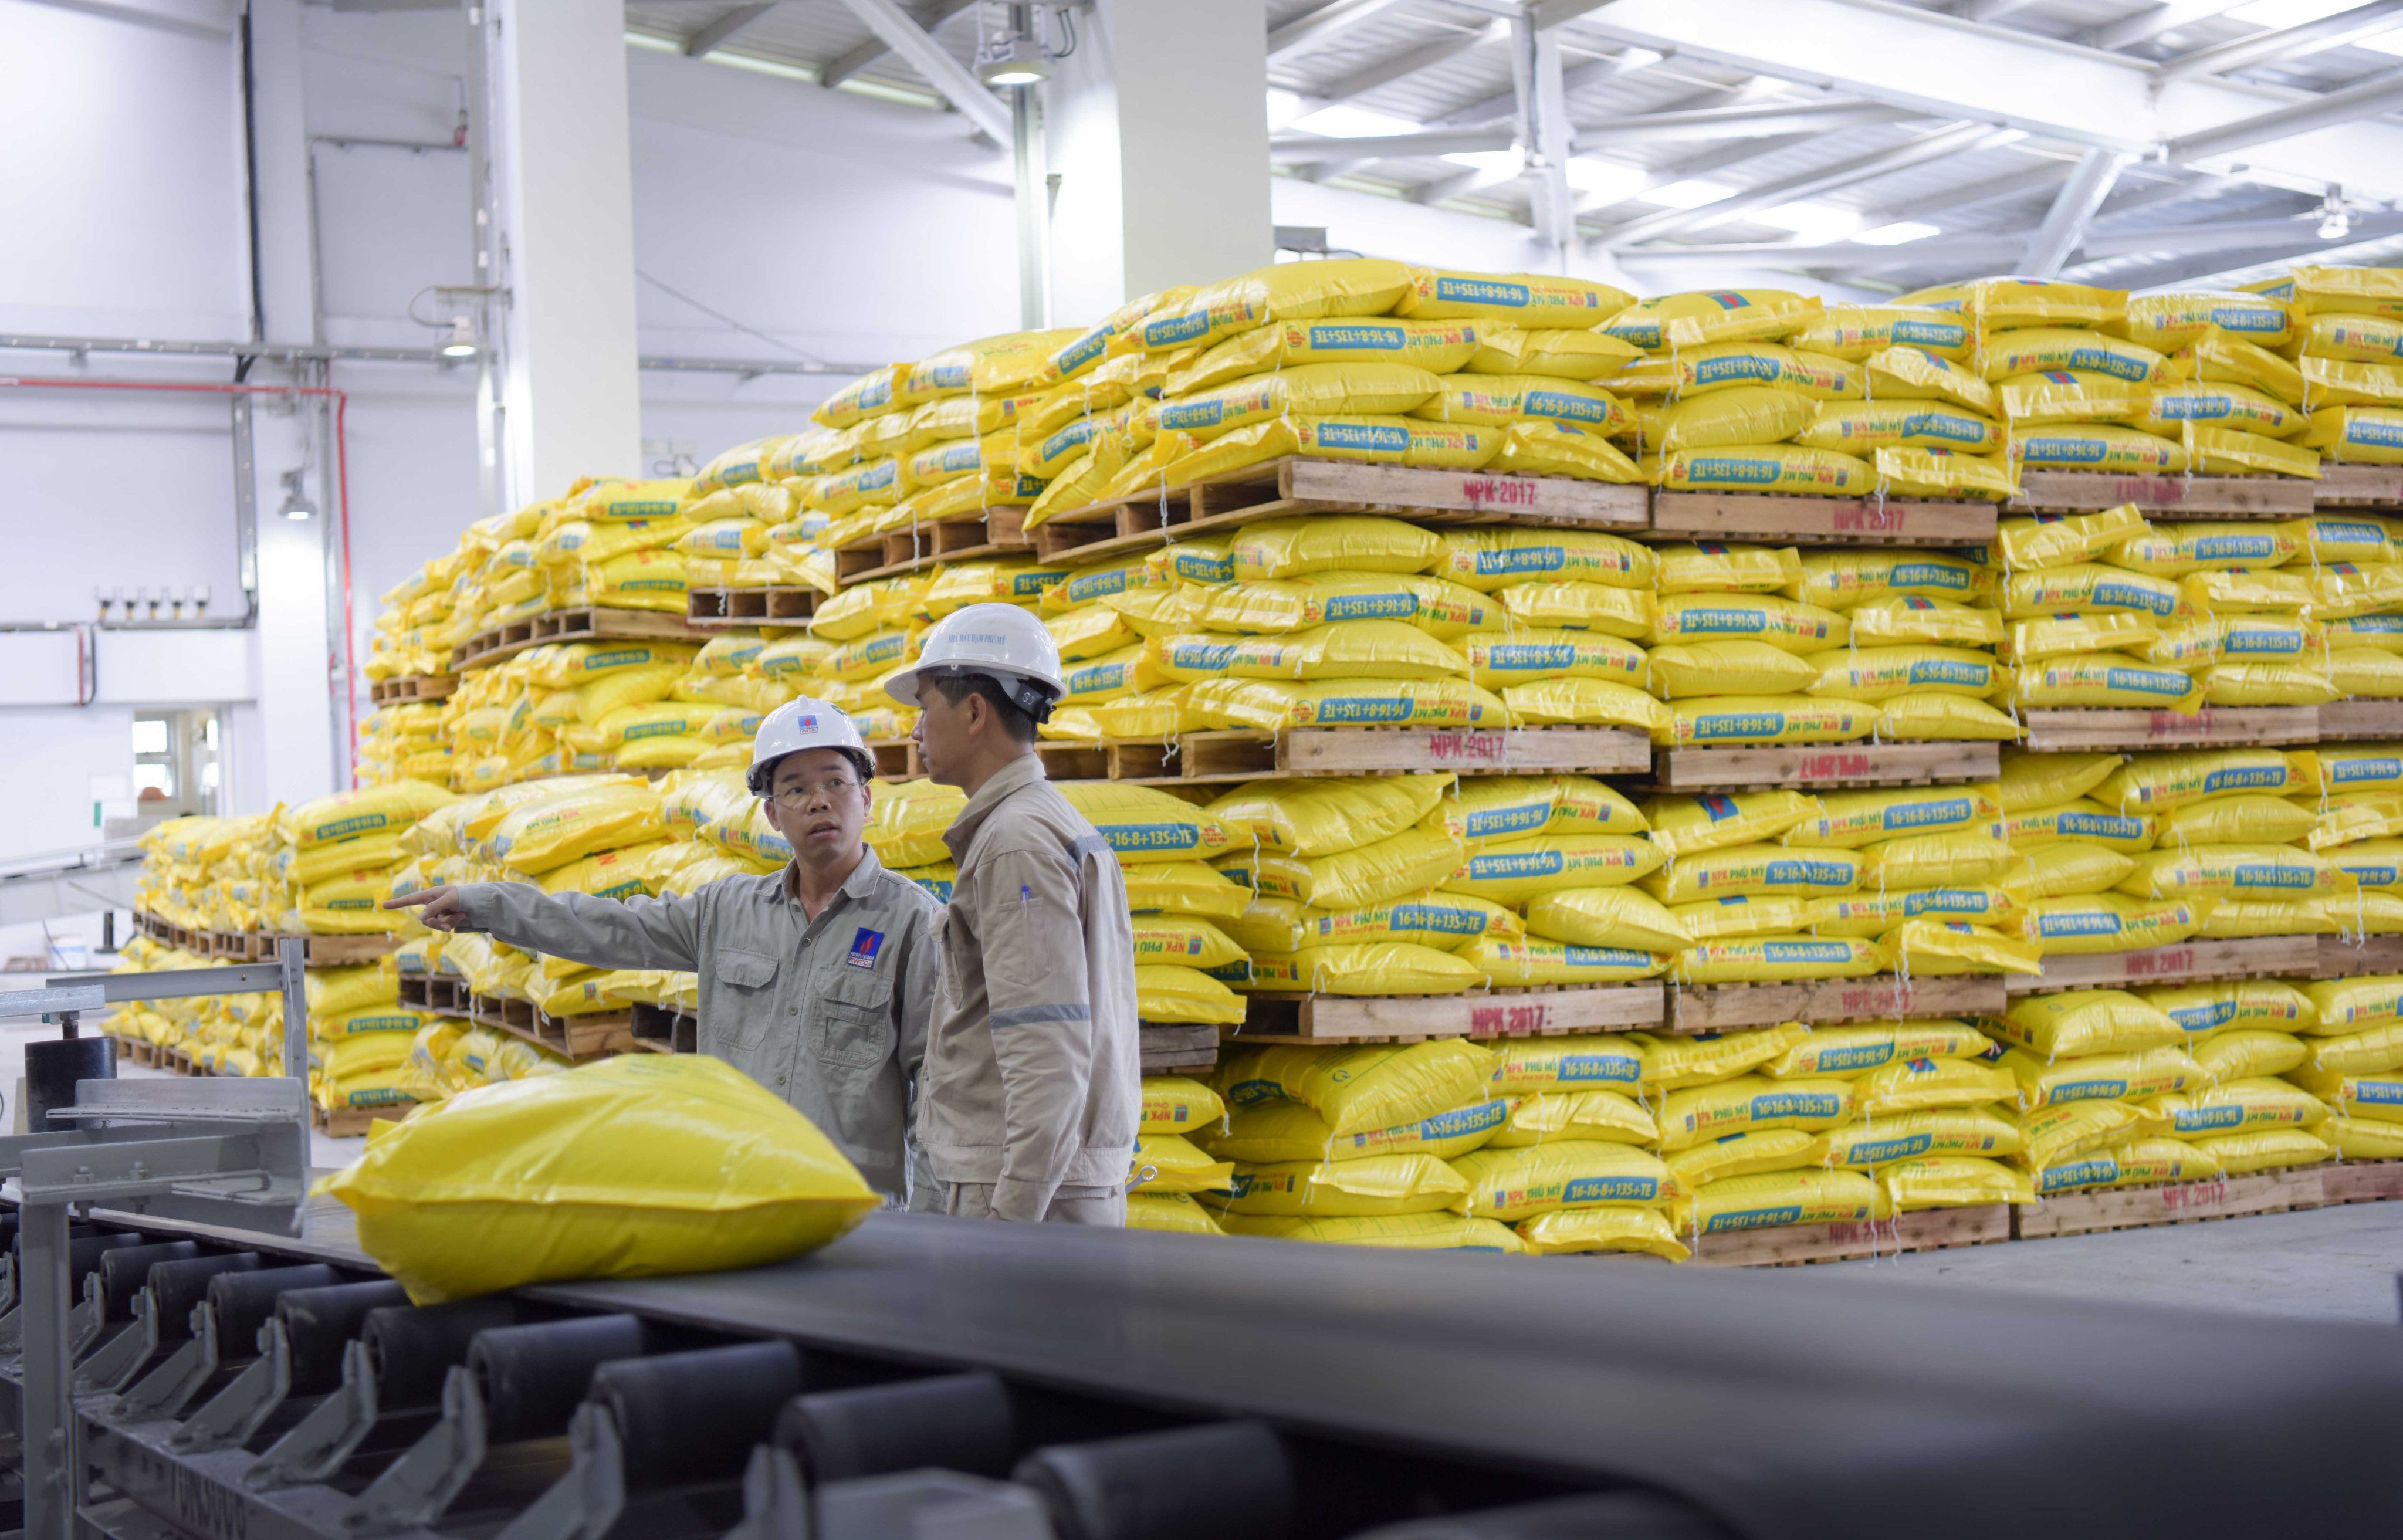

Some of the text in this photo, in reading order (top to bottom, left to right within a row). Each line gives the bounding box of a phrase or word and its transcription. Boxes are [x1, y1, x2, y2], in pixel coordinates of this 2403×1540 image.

[1499, 481, 1535, 505] 2017
[1429, 734, 1463, 759] NPK
[1471, 809, 1544, 831] 16-16-8+13S+TE
[1579, 809, 1598, 819] NPK
[1104, 829, 1192, 846] 6-16-8+13S+TE
[1605, 857, 1623, 867] NPK
[1165, 941, 1186, 953] NPK
[848, 957, 871, 967] PVFCCo
[1151, 1111, 1172, 1121] NPK
[1508, 1190, 1524, 1201] NPK
[1572, 1182, 1653, 1199] 16-16-8+13S+TE
